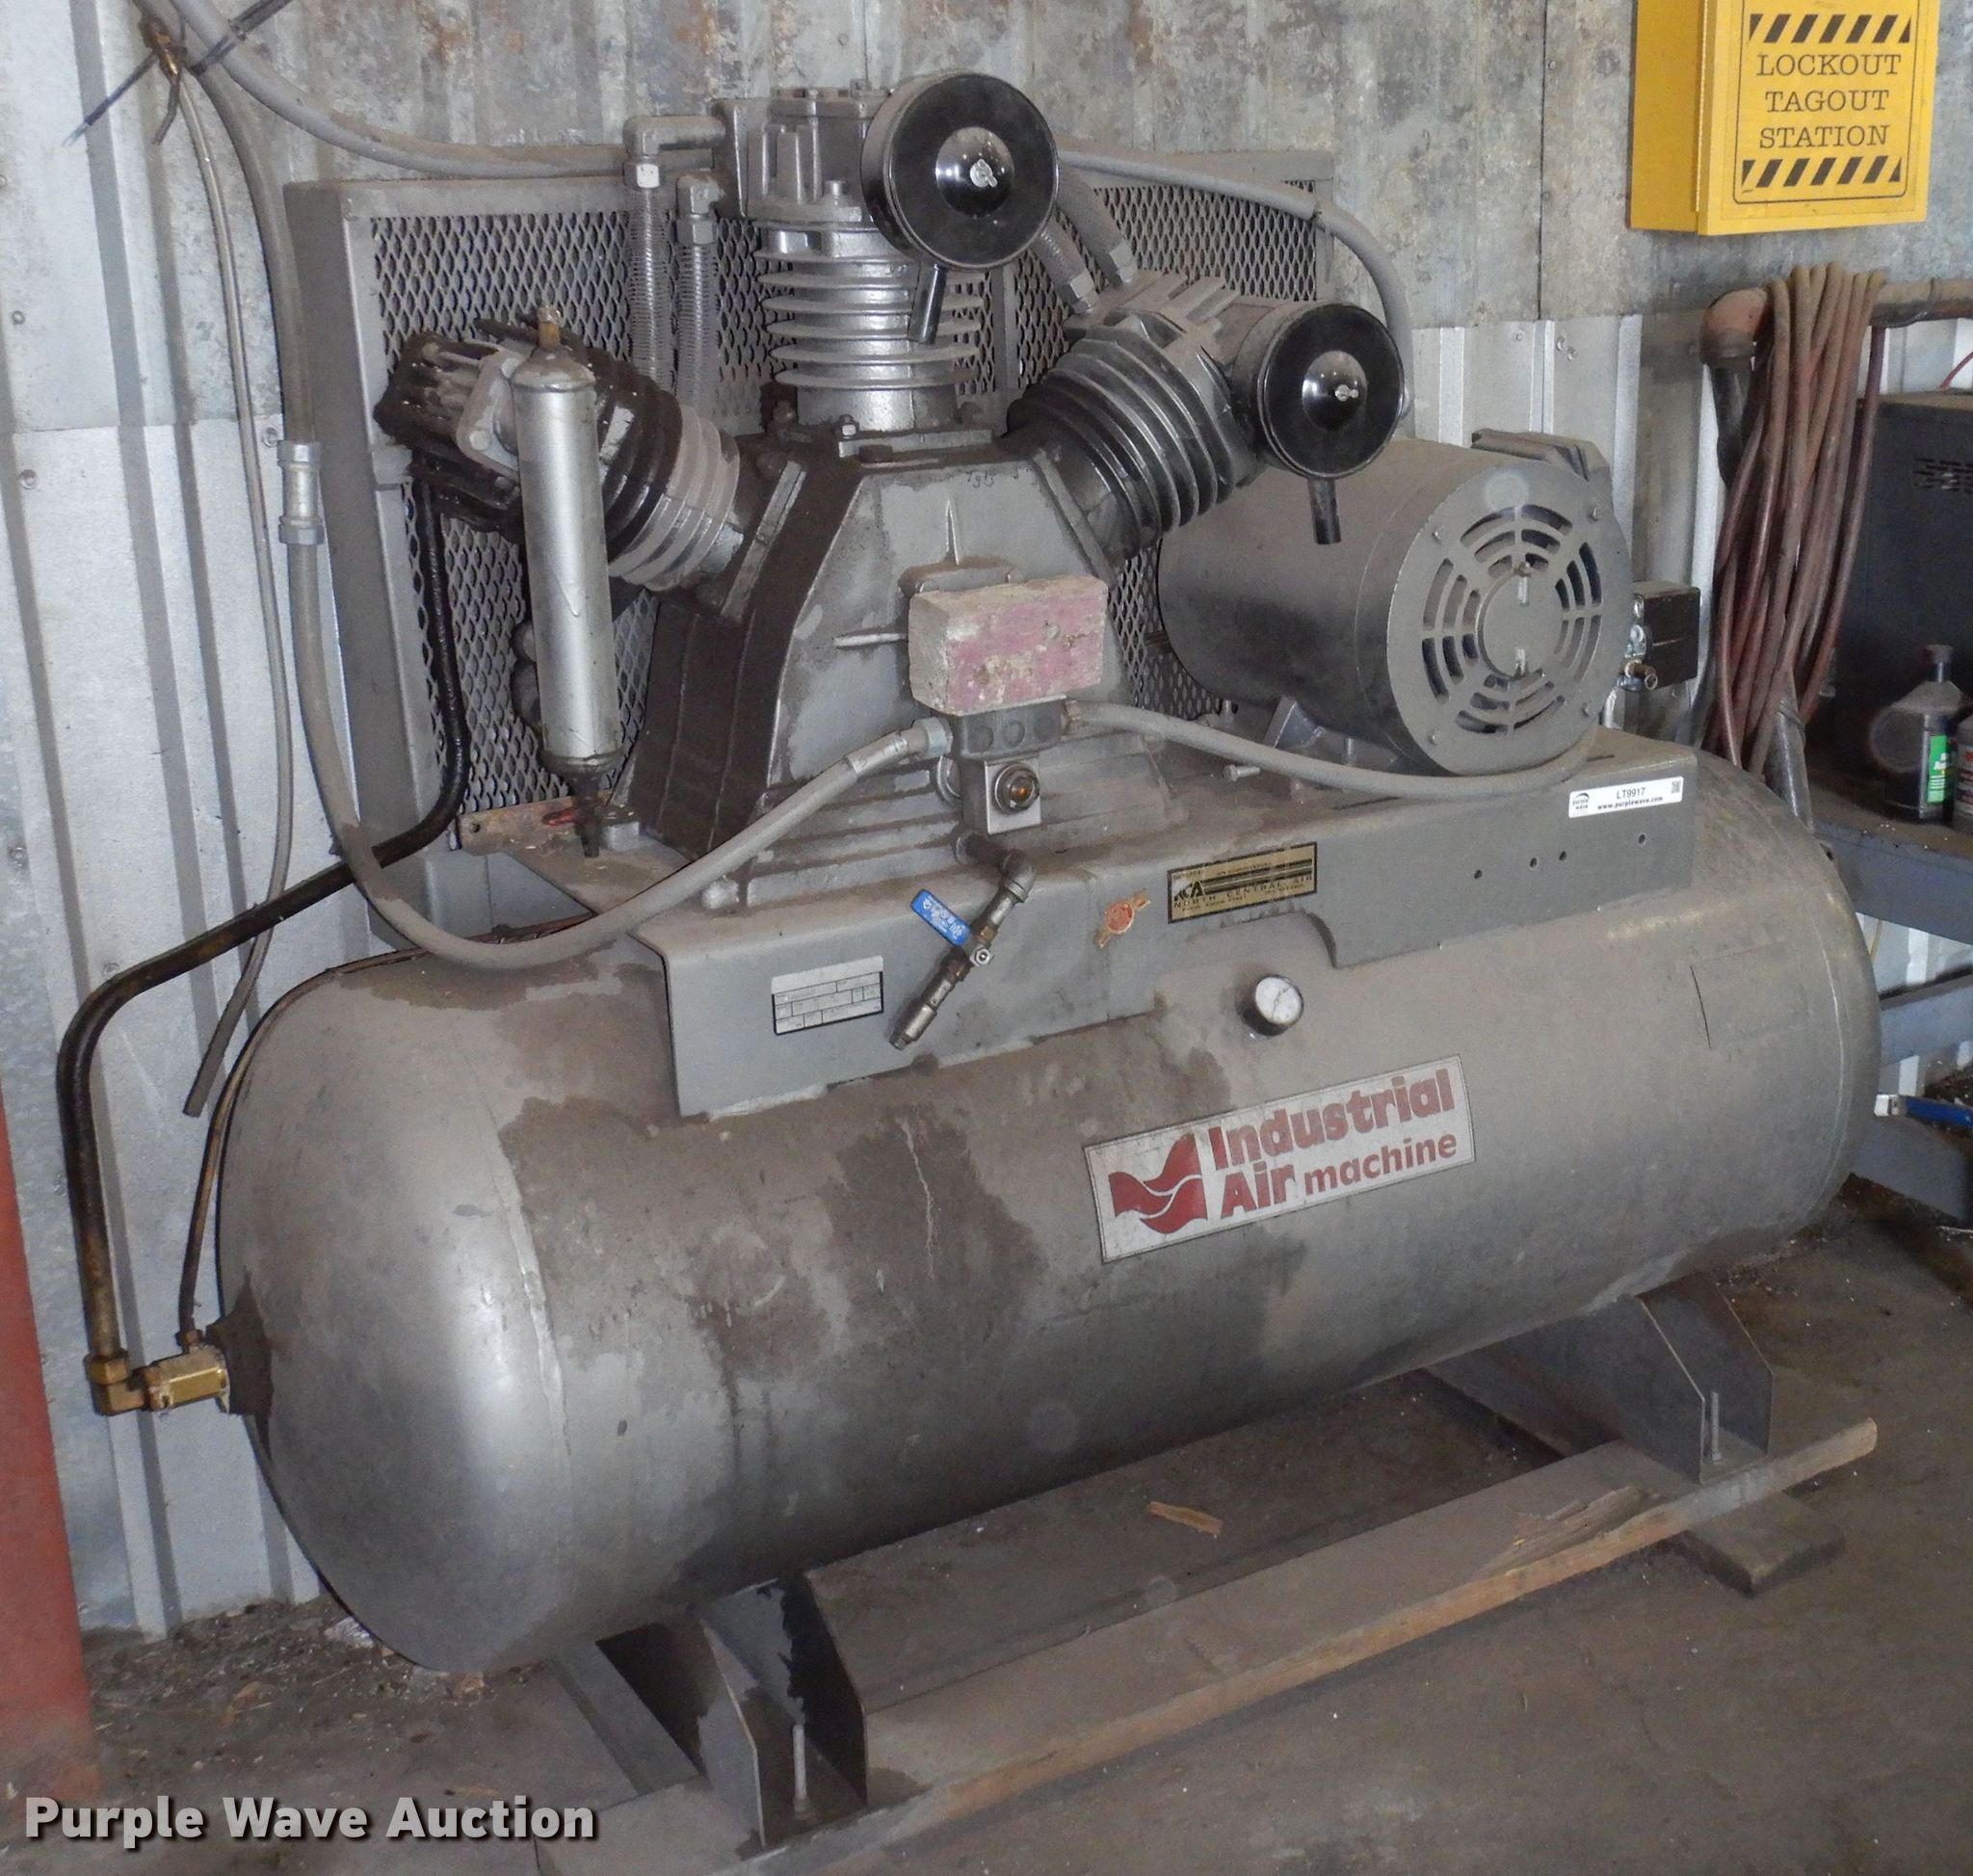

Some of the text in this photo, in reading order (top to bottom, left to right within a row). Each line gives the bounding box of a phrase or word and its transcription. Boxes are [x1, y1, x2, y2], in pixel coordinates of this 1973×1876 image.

[1756, 54, 1902, 76] LOCKOUT
[1765, 90, 1889, 113] TAGOUT
[1759, 124, 1890, 149] STATION
[1597, 796, 1664, 810] www.purplewave.com
[1616, 786, 1646, 800] LT9917
[1208, 1068, 1456, 1171] Industrial
[1221, 1132, 1457, 1220] Air machine
